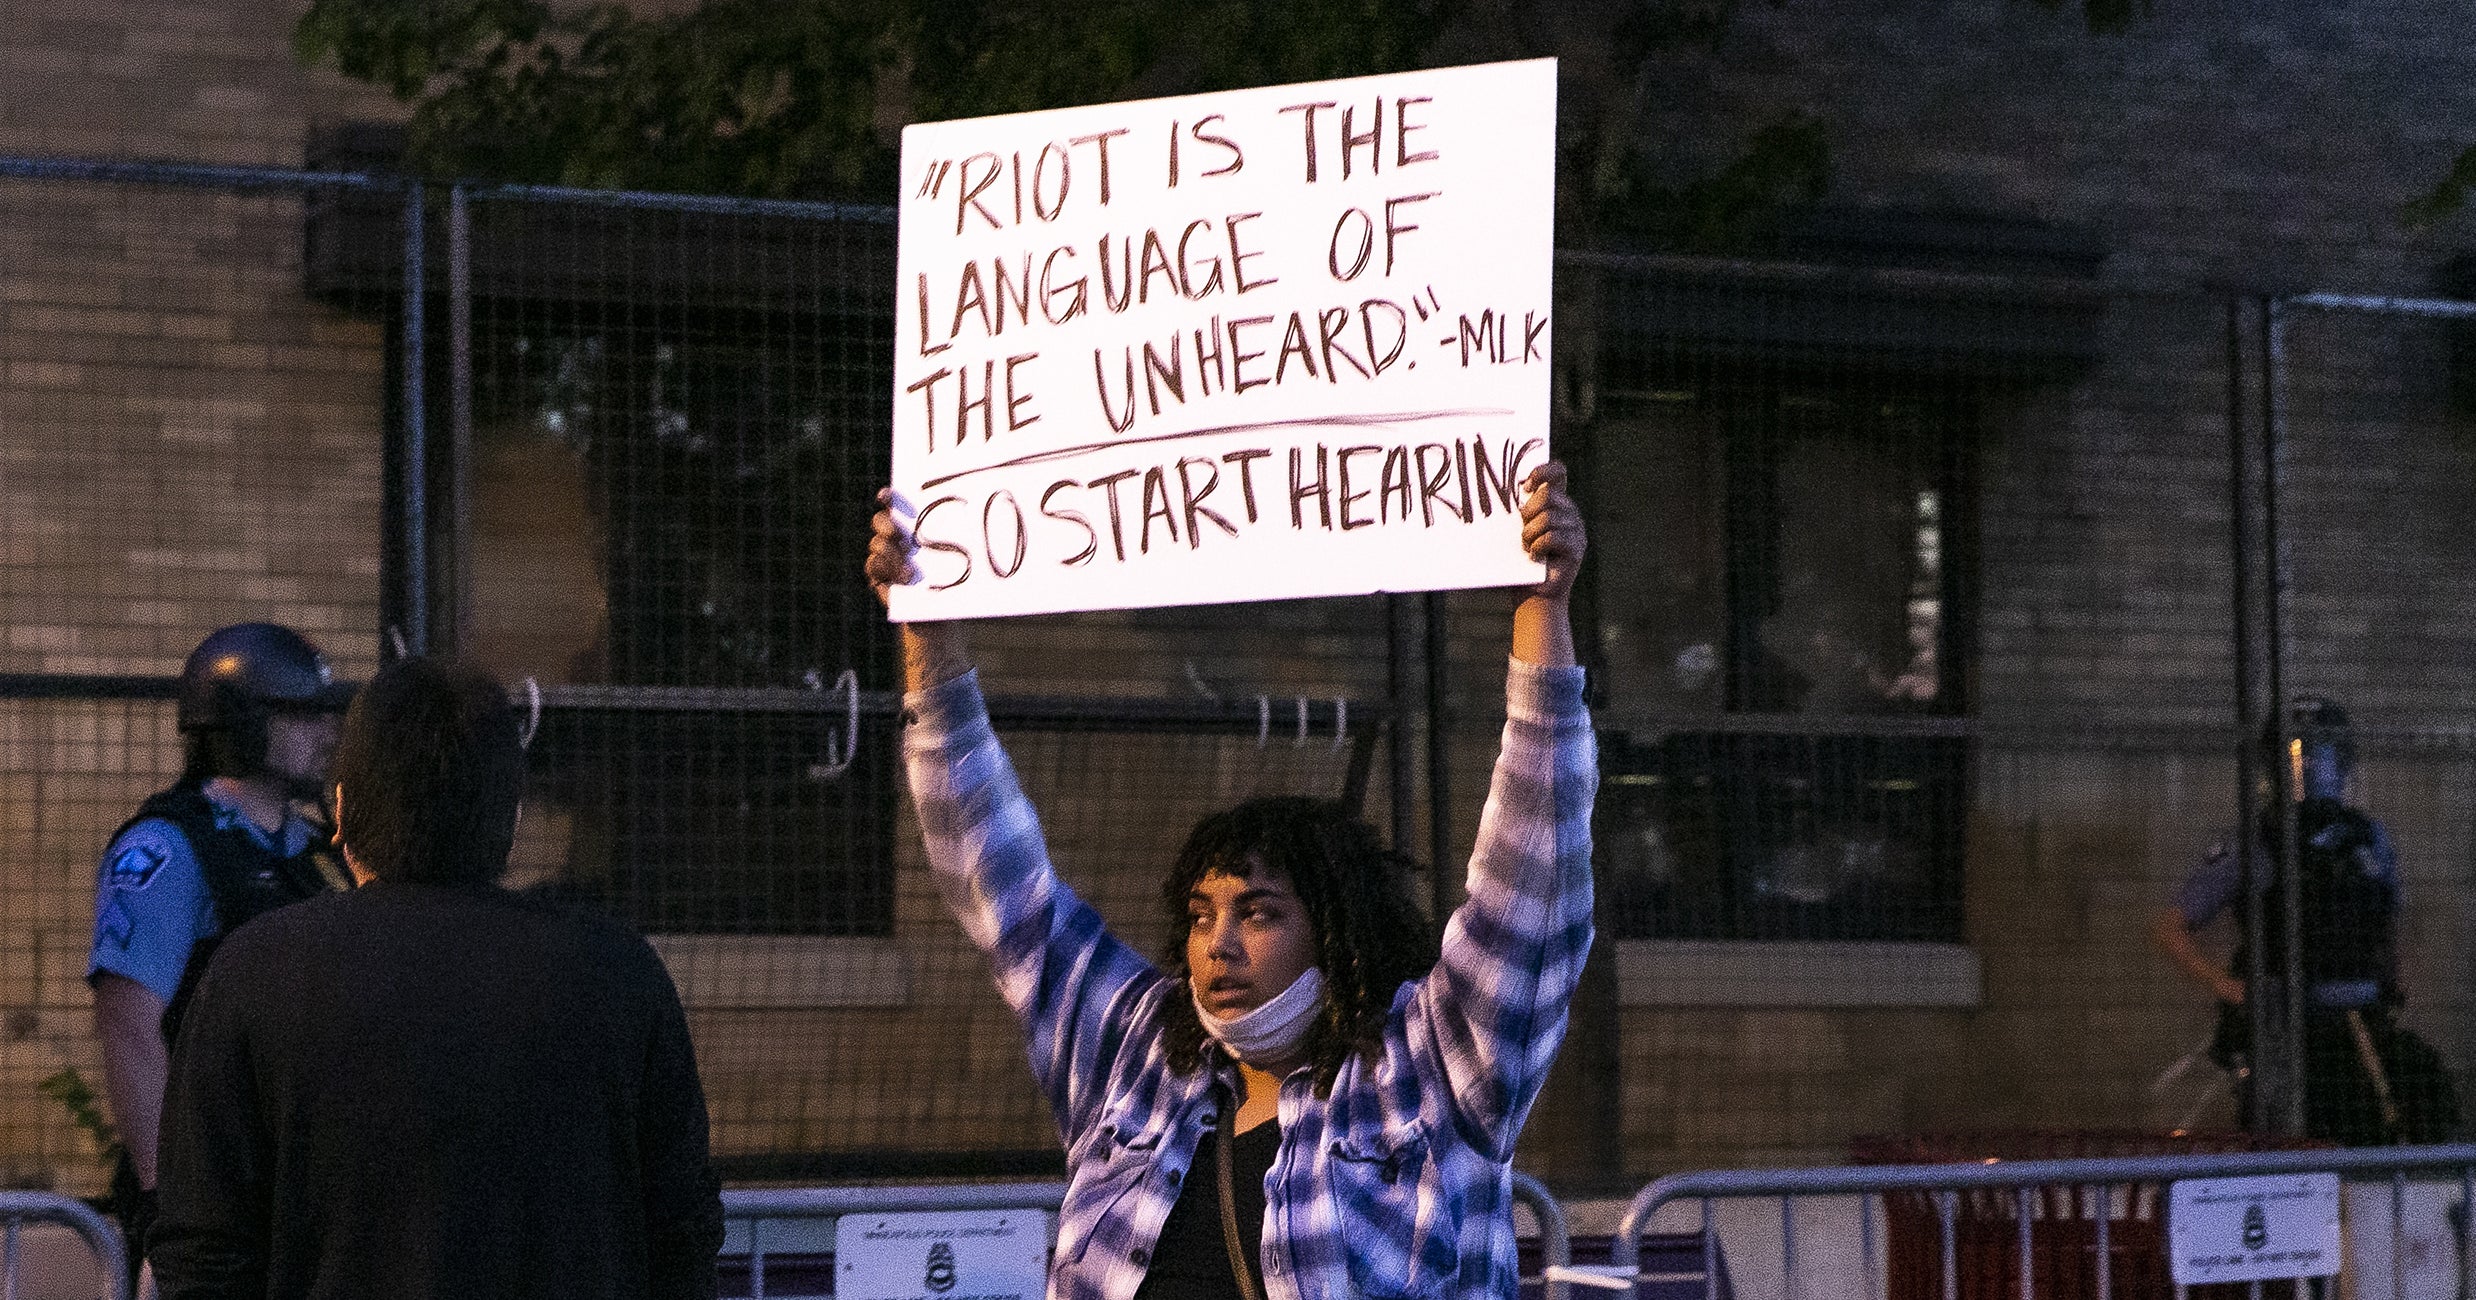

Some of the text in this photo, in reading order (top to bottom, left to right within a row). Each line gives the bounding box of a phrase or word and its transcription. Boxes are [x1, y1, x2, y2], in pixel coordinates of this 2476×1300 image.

[915, 96, 1440, 235] "RIOT IS THE
[918, 192, 1443, 357] LANGUAGE OF
[906, 285, 1548, 454] THE UNHEARD." -MLK
[914, 490, 1028, 591] SO
[1040, 448, 1271, 566] START
